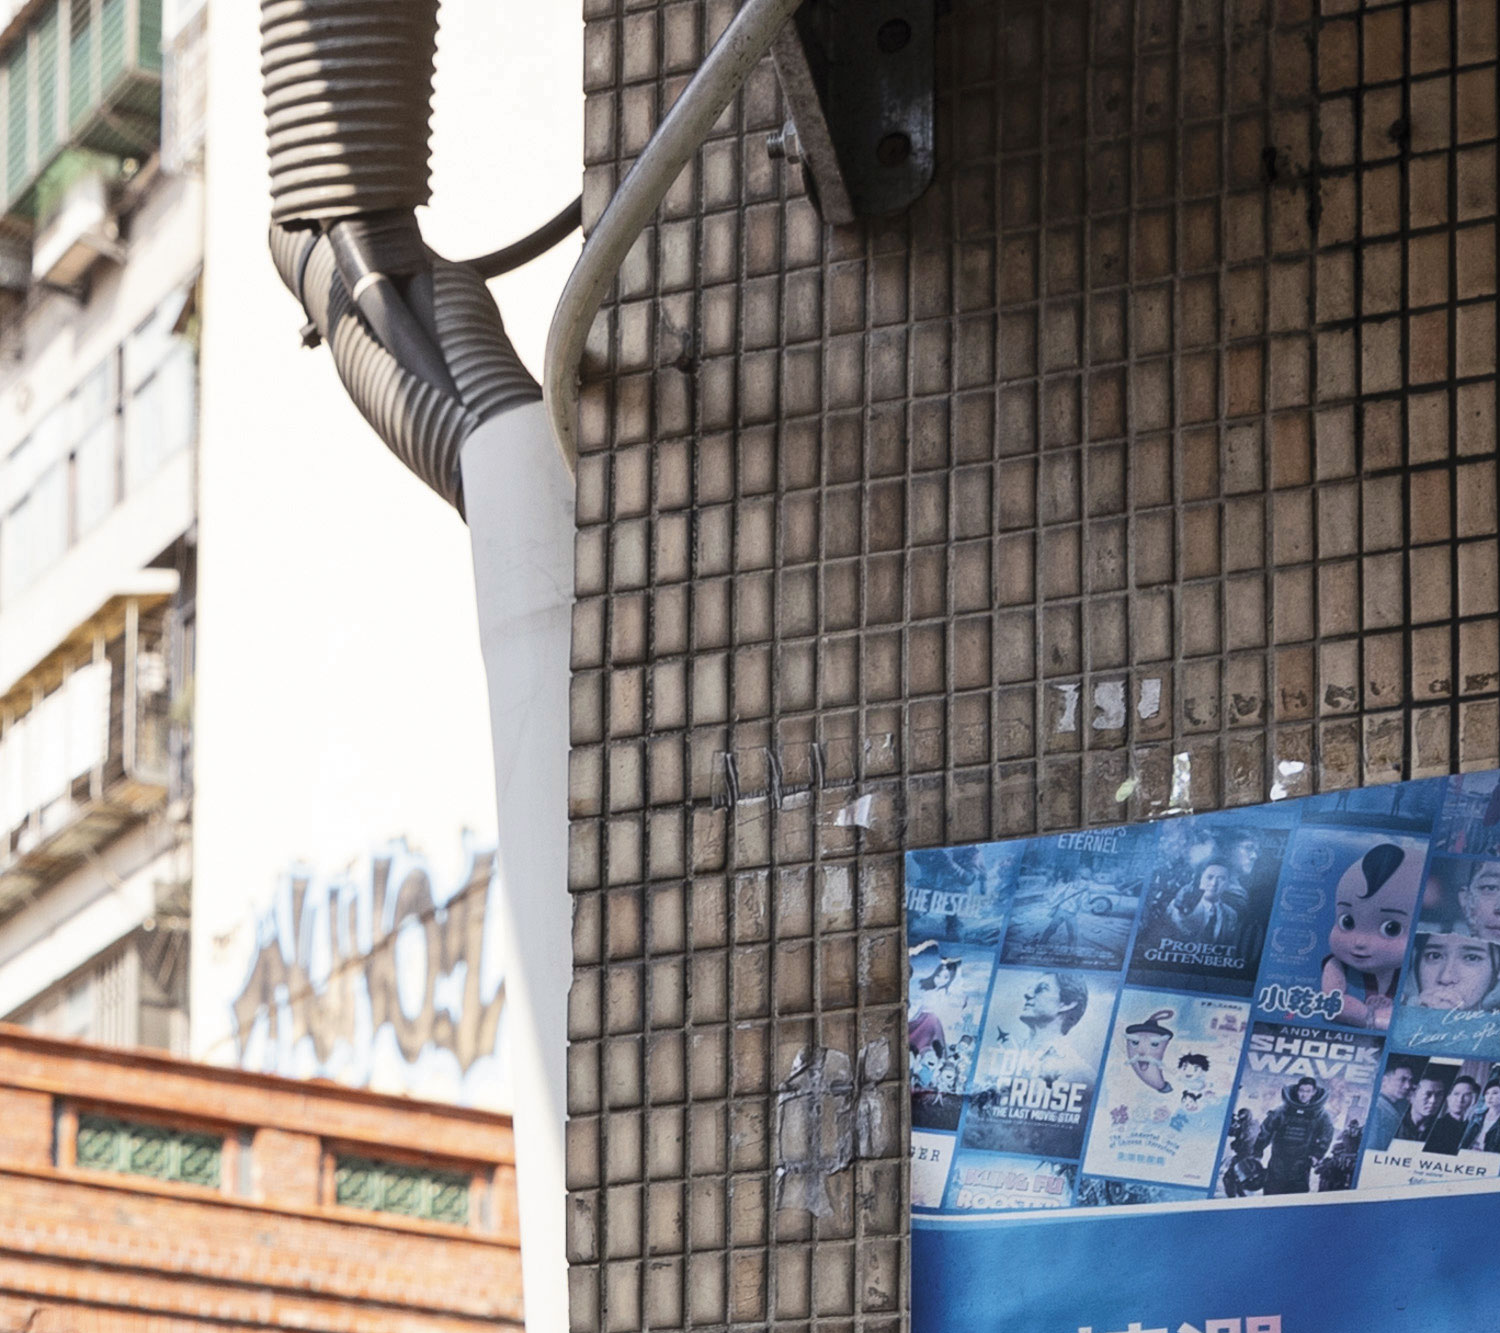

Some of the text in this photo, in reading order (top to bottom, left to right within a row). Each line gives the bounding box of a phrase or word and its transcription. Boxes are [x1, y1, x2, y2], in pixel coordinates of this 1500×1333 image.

[1057, 834, 1118, 853] ETERNEL
[1159, 938, 1237, 956] PROJECT
[1144, 950, 1245, 969] GUTENBERG
[1258, 984, 1344, 1020] 小乾坤
[1280, 1026, 1354, 1042] ANDY LAU
[1250, 1034, 1382, 1065] SHOCK
[1248, 1053, 1379, 1084] WAVE
[997, 1076, 1087, 1113] CRUISE
[992, 1107, 1007, 1118] THE
[1008, 1109, 1029, 1120] LAST
[1057, 1113, 1081, 1124] STAR
[1374, 1154, 1412, 1168] LINE
[1419, 1159, 1487, 1176] WALKER
[965, 1169, 1065, 1195] KUNG FU
